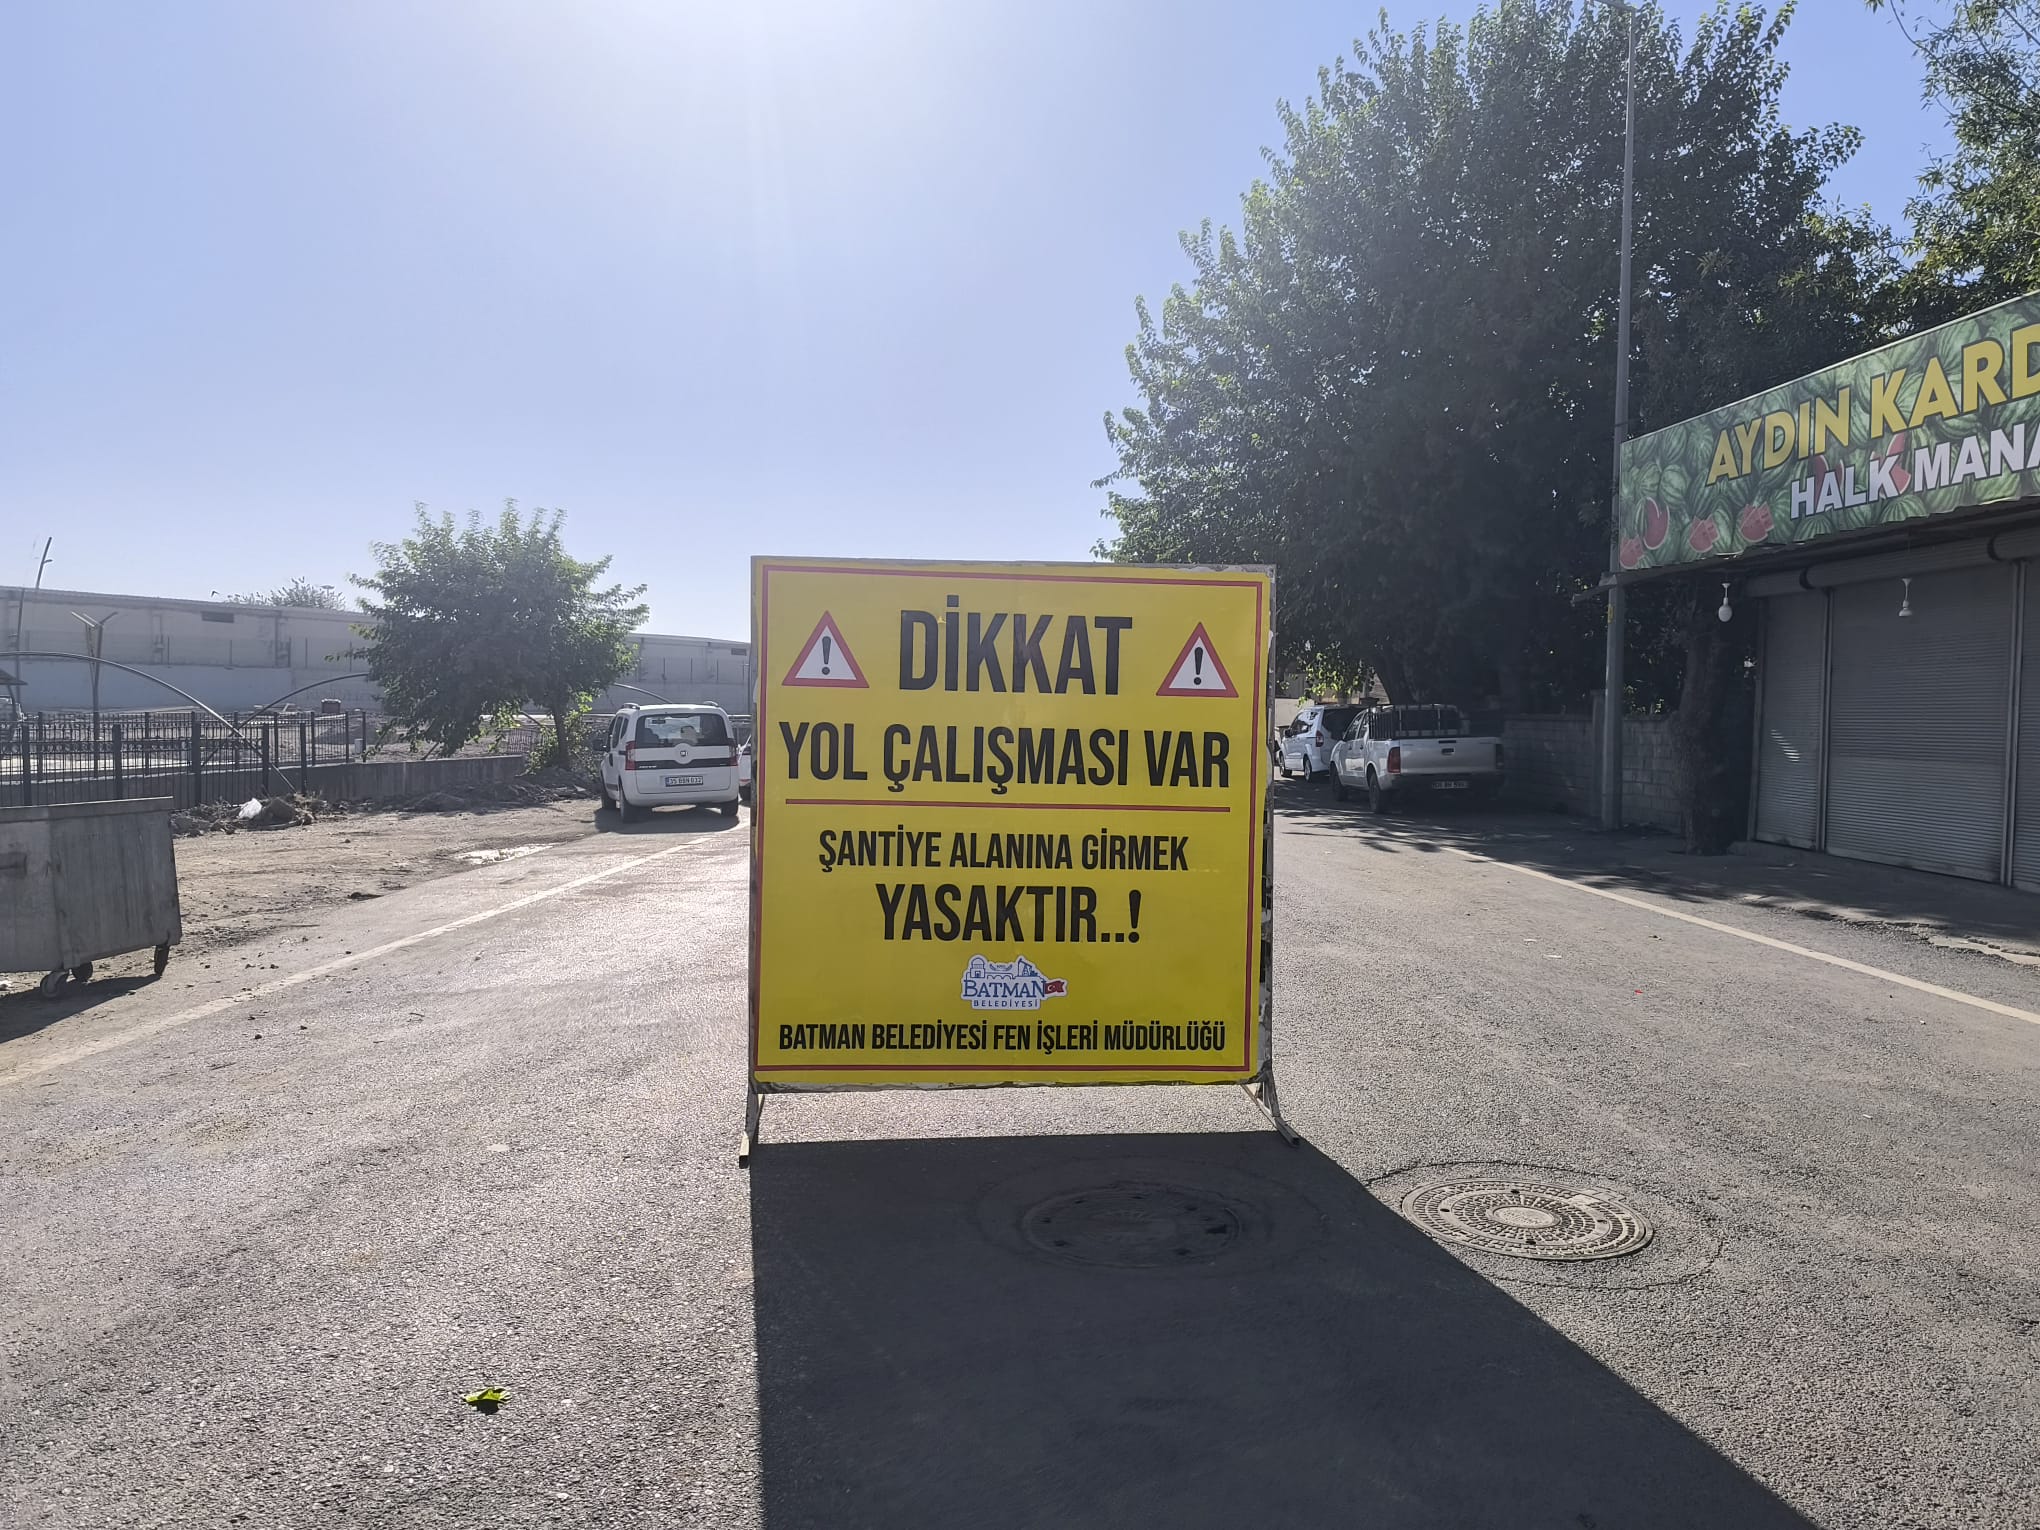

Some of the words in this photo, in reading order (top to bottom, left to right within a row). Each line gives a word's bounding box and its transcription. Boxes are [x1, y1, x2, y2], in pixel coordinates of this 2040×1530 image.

[1707, 388, 1850, 486] AYDIN
[1871, 323, 2040, 438] KARD
[1790, 452, 1900, 521] HALK
[899, 594, 1132, 696] DİKKAT
[779, 721, 867, 781] YOL
[883, 723, 1129, 795] ÇALIŞMASI
[1143, 730, 1230, 788] VAR
[819, 824, 942, 873] ŞANTİYE
[950, 832, 1073, 870] ALANINA
[1081, 827, 1189, 871] GİRMEK
[876, 883, 1142, 944] YASAKTIR..!
[963, 980, 1046, 998] BATMAN
[974, 999, 1038, 1007] BELEDİYESİ
[779, 1023, 866, 1050] BATMAN
[872, 1018, 988, 1051] BELEDİYESİ
[993, 1024, 1031, 1051] FEN
[1036, 1019, 1099, 1056] İŞLERİ
[1104, 1019, 1226, 1052] MÜDÜRLÜĞÜ
